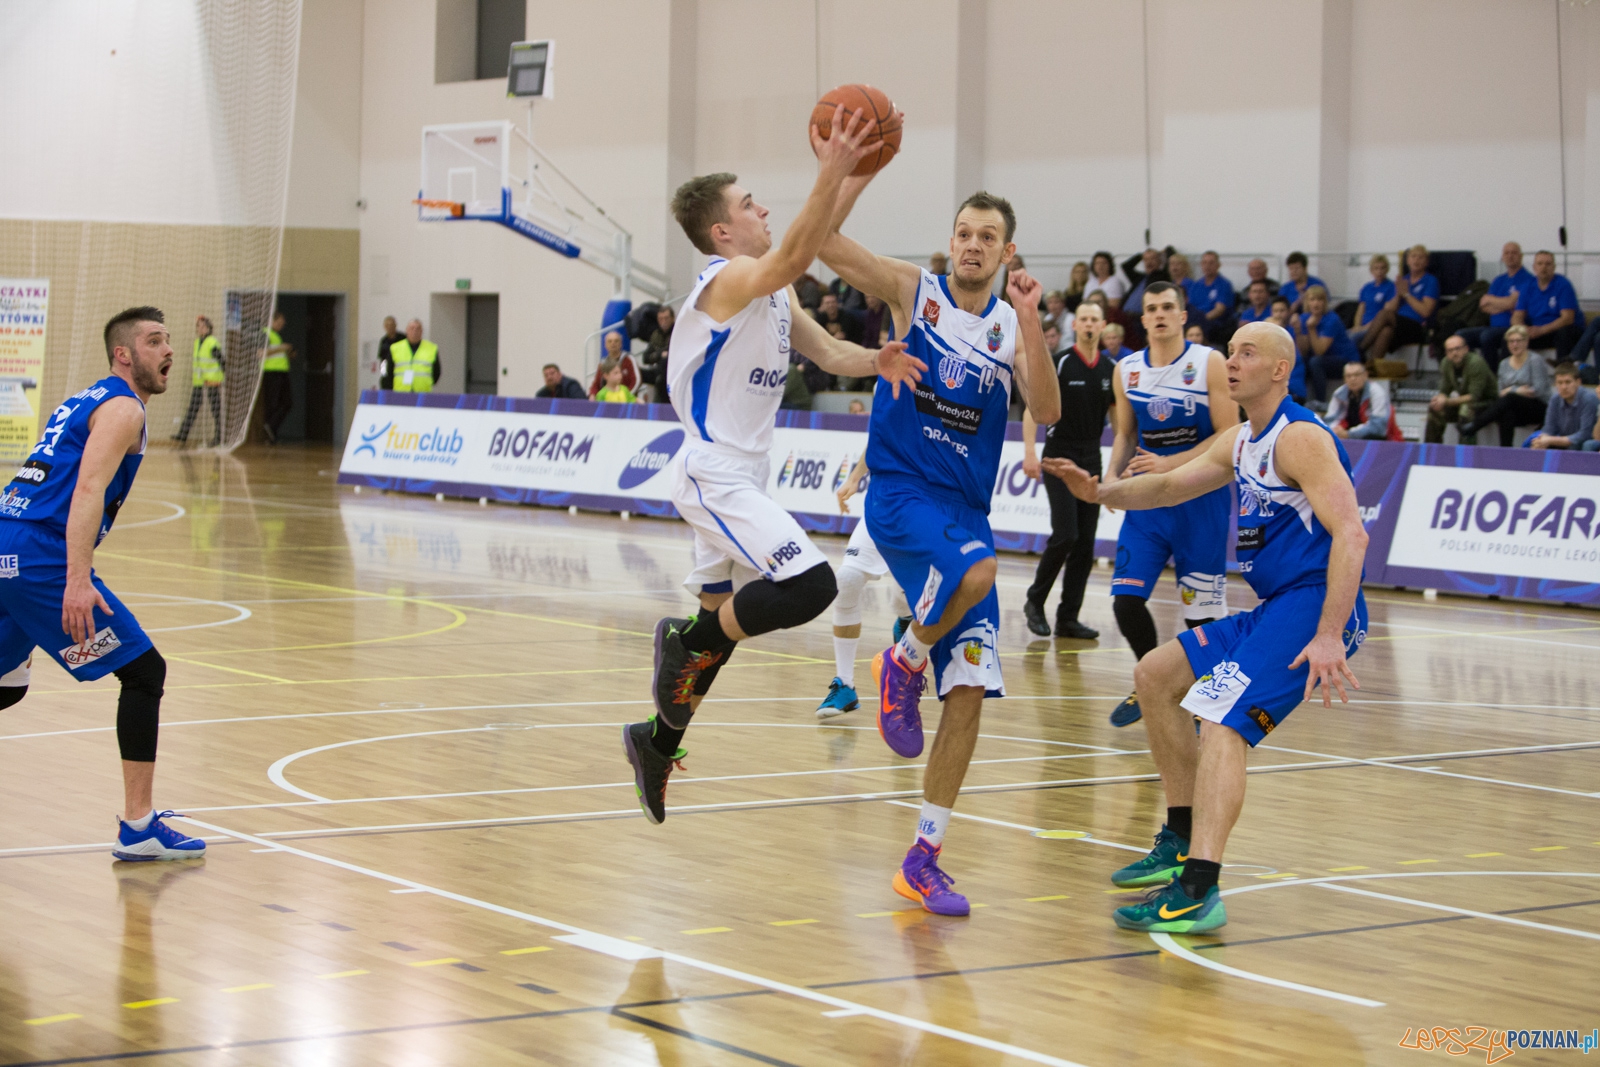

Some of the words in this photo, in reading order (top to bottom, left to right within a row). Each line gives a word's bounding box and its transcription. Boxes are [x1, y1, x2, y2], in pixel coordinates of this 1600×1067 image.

[1183, 394, 1197, 417] 9
[385, 424, 463, 453] funclub
[488, 427, 597, 463] BIOFARM
[630, 447, 671, 470] atrem
[789, 458, 827, 490] PBG
[1430, 488, 1600, 541] BIOFAR
[772, 541, 802, 566] PBG
[1440, 538, 1482, 553] POLSKI
[1486, 542, 1560, 559] PRODUCENT
